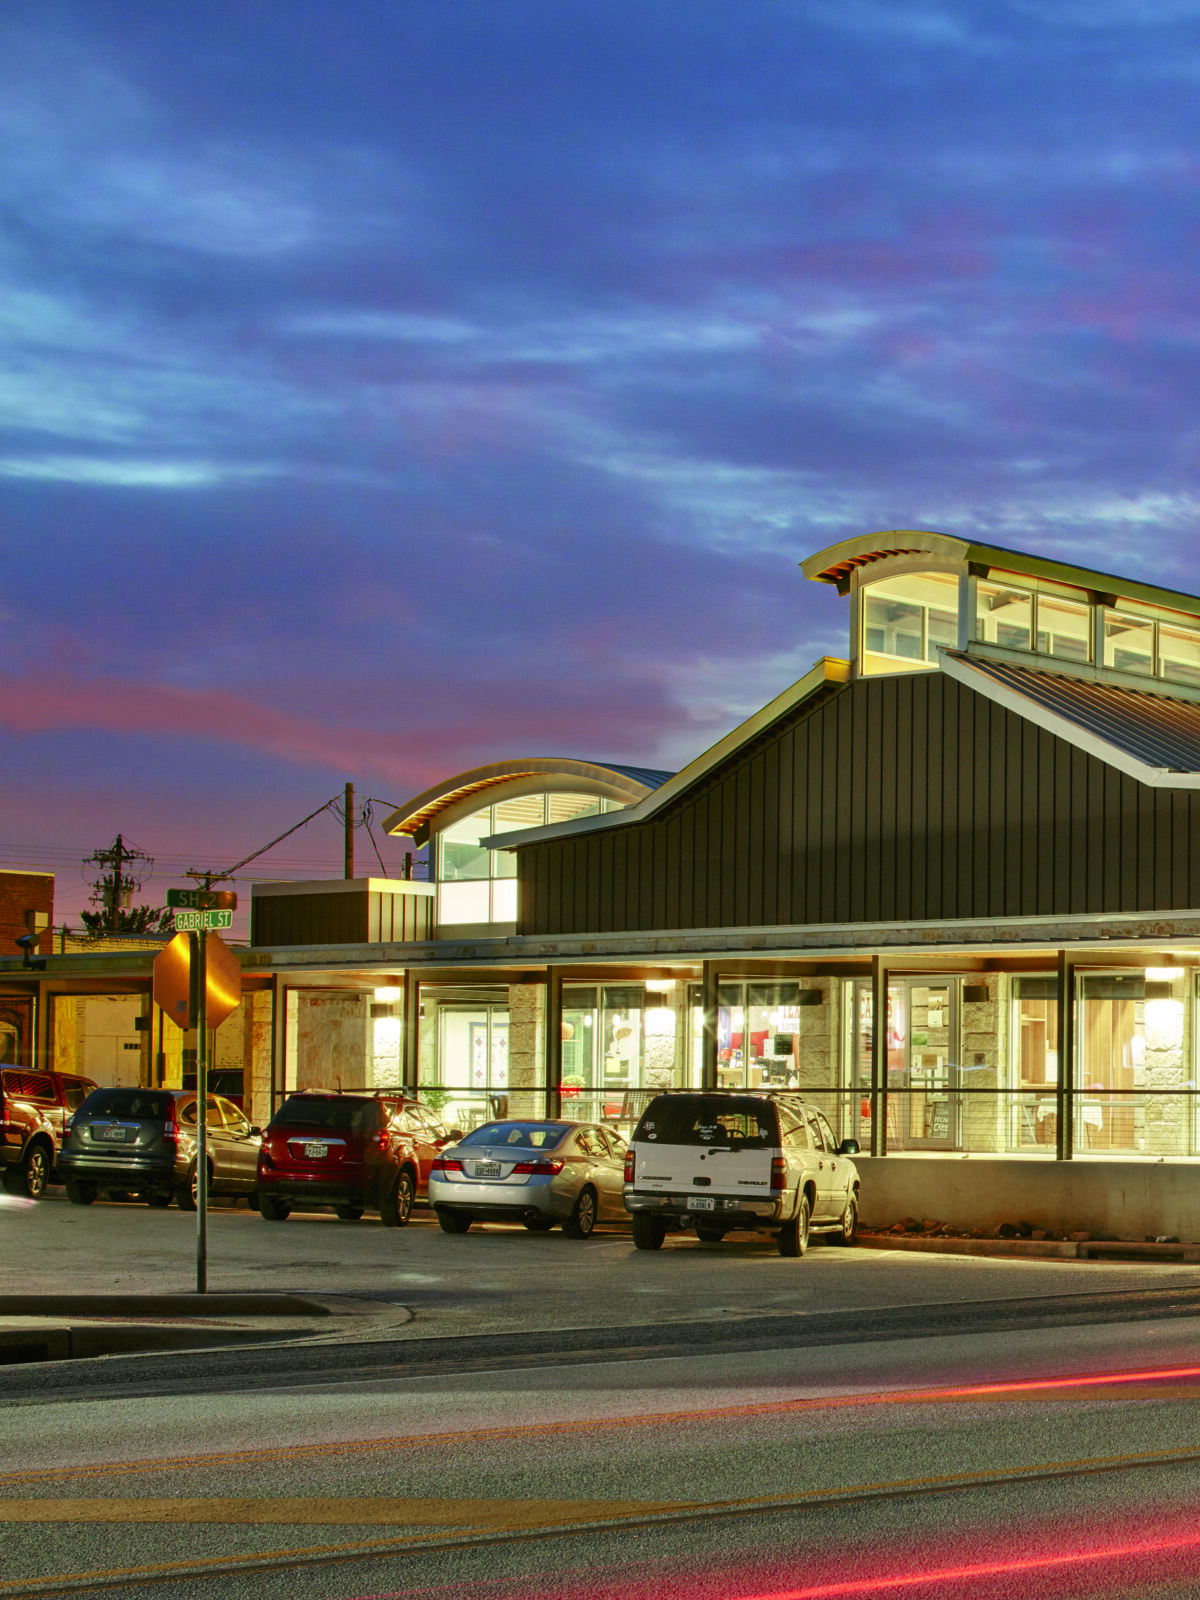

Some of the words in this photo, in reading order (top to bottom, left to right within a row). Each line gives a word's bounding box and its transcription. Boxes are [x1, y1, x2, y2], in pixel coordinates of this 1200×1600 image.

[178, 891, 199, 907] SH
[177, 912, 214, 929] GABRIEL
[217, 911, 230, 927] ST
